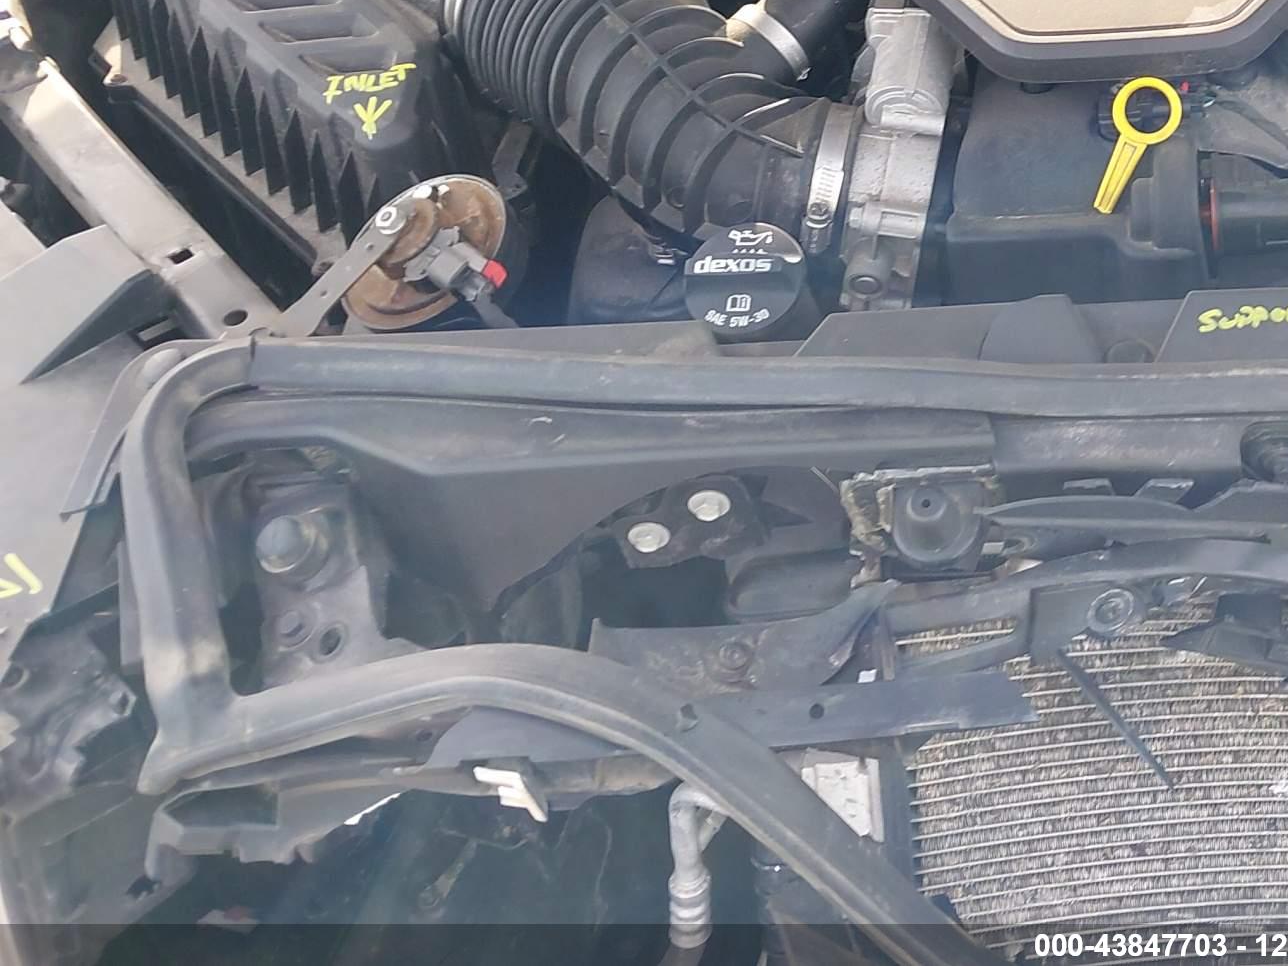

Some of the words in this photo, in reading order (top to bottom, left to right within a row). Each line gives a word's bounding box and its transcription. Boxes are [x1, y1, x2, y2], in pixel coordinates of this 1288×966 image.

[322, 62, 417, 104] INLET
[693, 255, 775, 274] dexos
[704, 309, 728, 326] SAE
[729, 308, 771, 328] 5W-30
